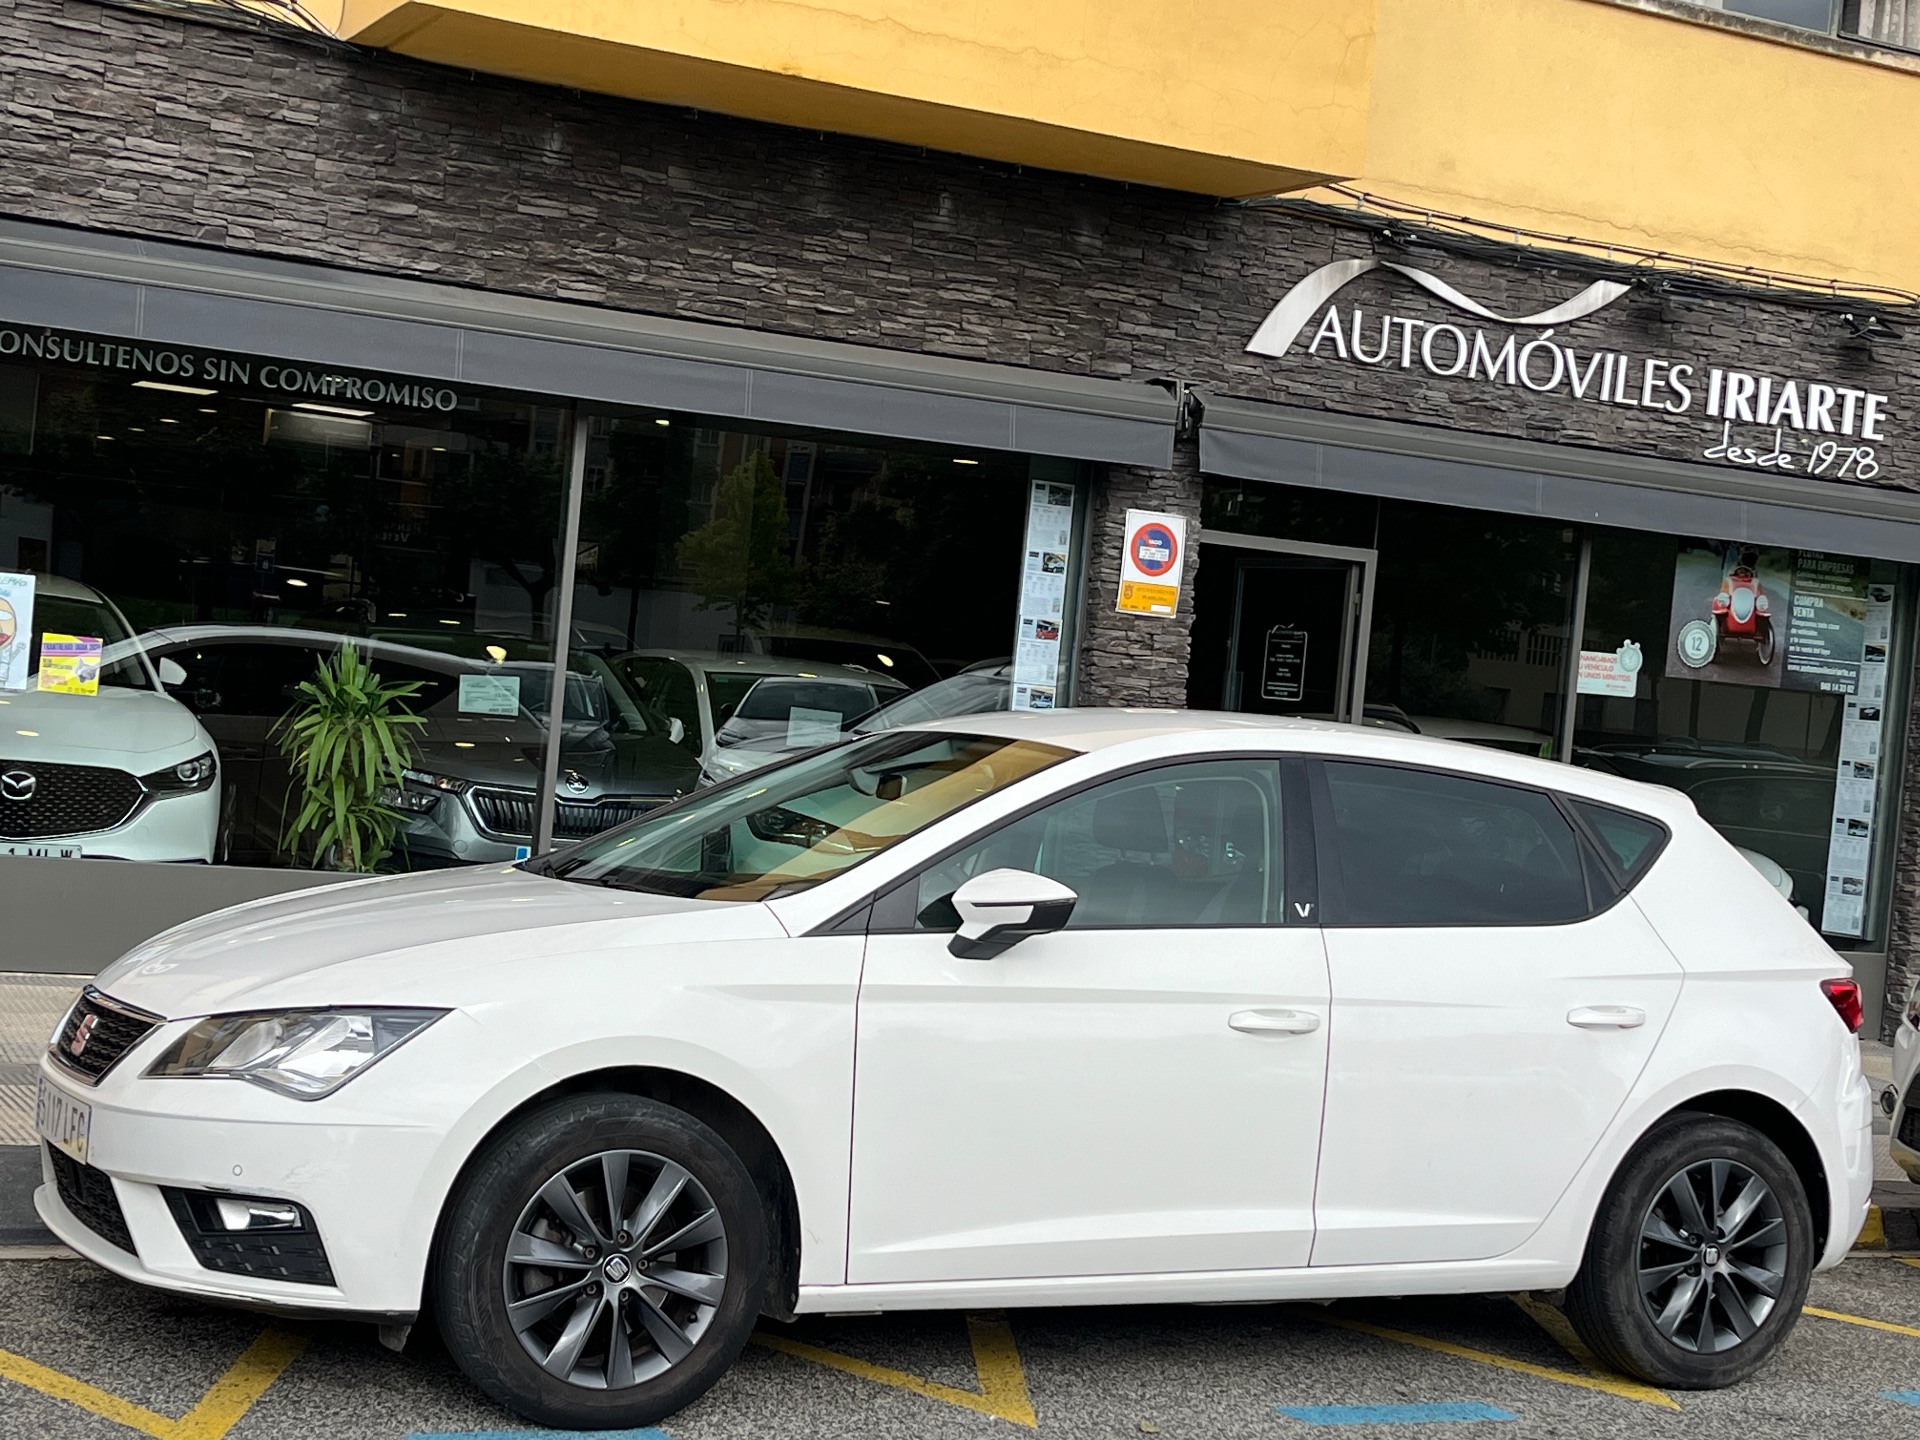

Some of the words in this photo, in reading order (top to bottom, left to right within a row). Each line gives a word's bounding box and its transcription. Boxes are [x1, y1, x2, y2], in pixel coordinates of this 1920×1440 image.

[203, 356, 250, 385] SIN
[260, 365, 458, 411] COMPROMISO
[1308, 305, 1692, 414] AUTOMÓVILES
[1705, 368, 1888, 441] IRIARTE
[1703, 419, 1796, 469] desde
[1807, 440, 1880, 480] 1978
[1792, 606, 1815, 618] VENTA
[1793, 594, 1824, 608] COMPRA
[1692, 636, 1703, 652] 12
